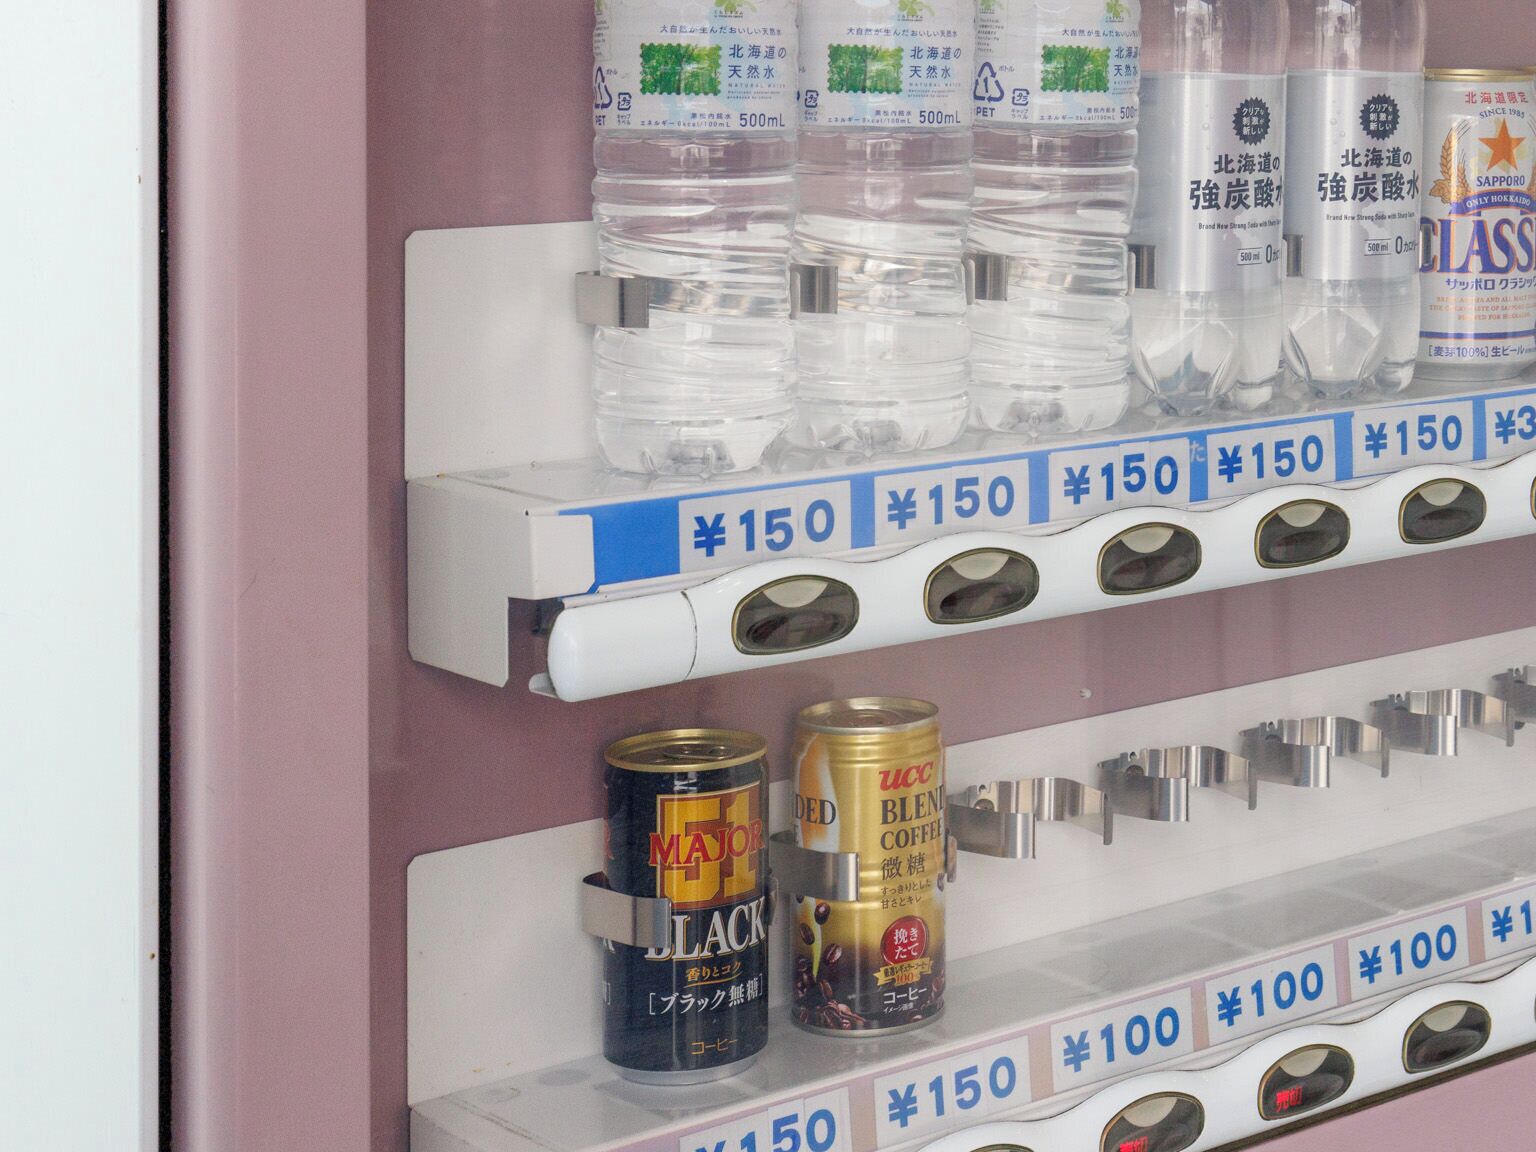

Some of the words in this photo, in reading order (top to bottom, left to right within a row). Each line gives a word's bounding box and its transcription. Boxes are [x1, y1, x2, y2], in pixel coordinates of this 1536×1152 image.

[659, 24, 782, 36] 大自然が生んだおいしい天然水
[847, 27, 958, 38] 大自然が生んだおいしい天然水
[728, 43, 787, 60] 北海道の
[910, 46, 962, 61] 北海道の
[727, 64, 775, 79] 天然水
[909, 65, 951, 79] 天然水
[1465, 91, 1528, 105] 北海道限定
[976, 107, 996, 118] PET
[1241, 107, 1264, 116] クリアな
[1369, 103, 1393, 112] クリアな
[1479, 108, 1507, 120] SINCE
[1508, 108, 1525, 120] 1985
[739, 113, 786, 128] 500mL
[919, 110, 961, 125] 500mL
[1242, 116, 1264, 126] 刺激が
[1369, 112, 1393, 122] 刺激が
[1243, 126, 1264, 136] 新しい
[1369, 122, 1392, 132] 新しい
[1213, 151, 1281, 175] 北海道の
[1341, 146, 1412, 169] 北海道の
[1318, 171, 1420, 203] 強炭酸水
[1476, 175, 1526, 188] SAPPORO
[1465, 196, 1490, 209] ONLY
[1491, 195, 1531, 208] HOKKAIDO
[1367, 242, 1380, 253] 500
[1446, 279, 1496, 290] サッポロ
[1491, 345, 1524, 357] 生ビール
[1364, 414, 1463, 459] ¥150
[1217, 434, 1324, 483] ¥150
[1063, 452, 1179, 505] ¥150
[887, 476, 1016, 530] ¥150
[694, 499, 836, 557] ¥150
[648, 818, 767, 868] MAJOR
[880, 852, 926, 880] 微糖
[880, 878, 932, 897] すっきりとした
[880, 894, 922, 910] 甘さとキレ
[894, 927, 918, 945] 挽き
[895, 943, 919, 960] たて
[1359, 924, 1458, 986] ¥100
[685, 962, 742, 982] 香りとコク
[649, 973, 763, 1016] [ブラック無糖]
[883, 987, 928, 1005] コーヒー
[1216, 962, 1324, 1028] ¥100
[690, 1038, 738, 1055] コーヒー
[1063, 1006, 1180, 1074] ¥100
[887, 1056, 1017, 1129] ¥150
